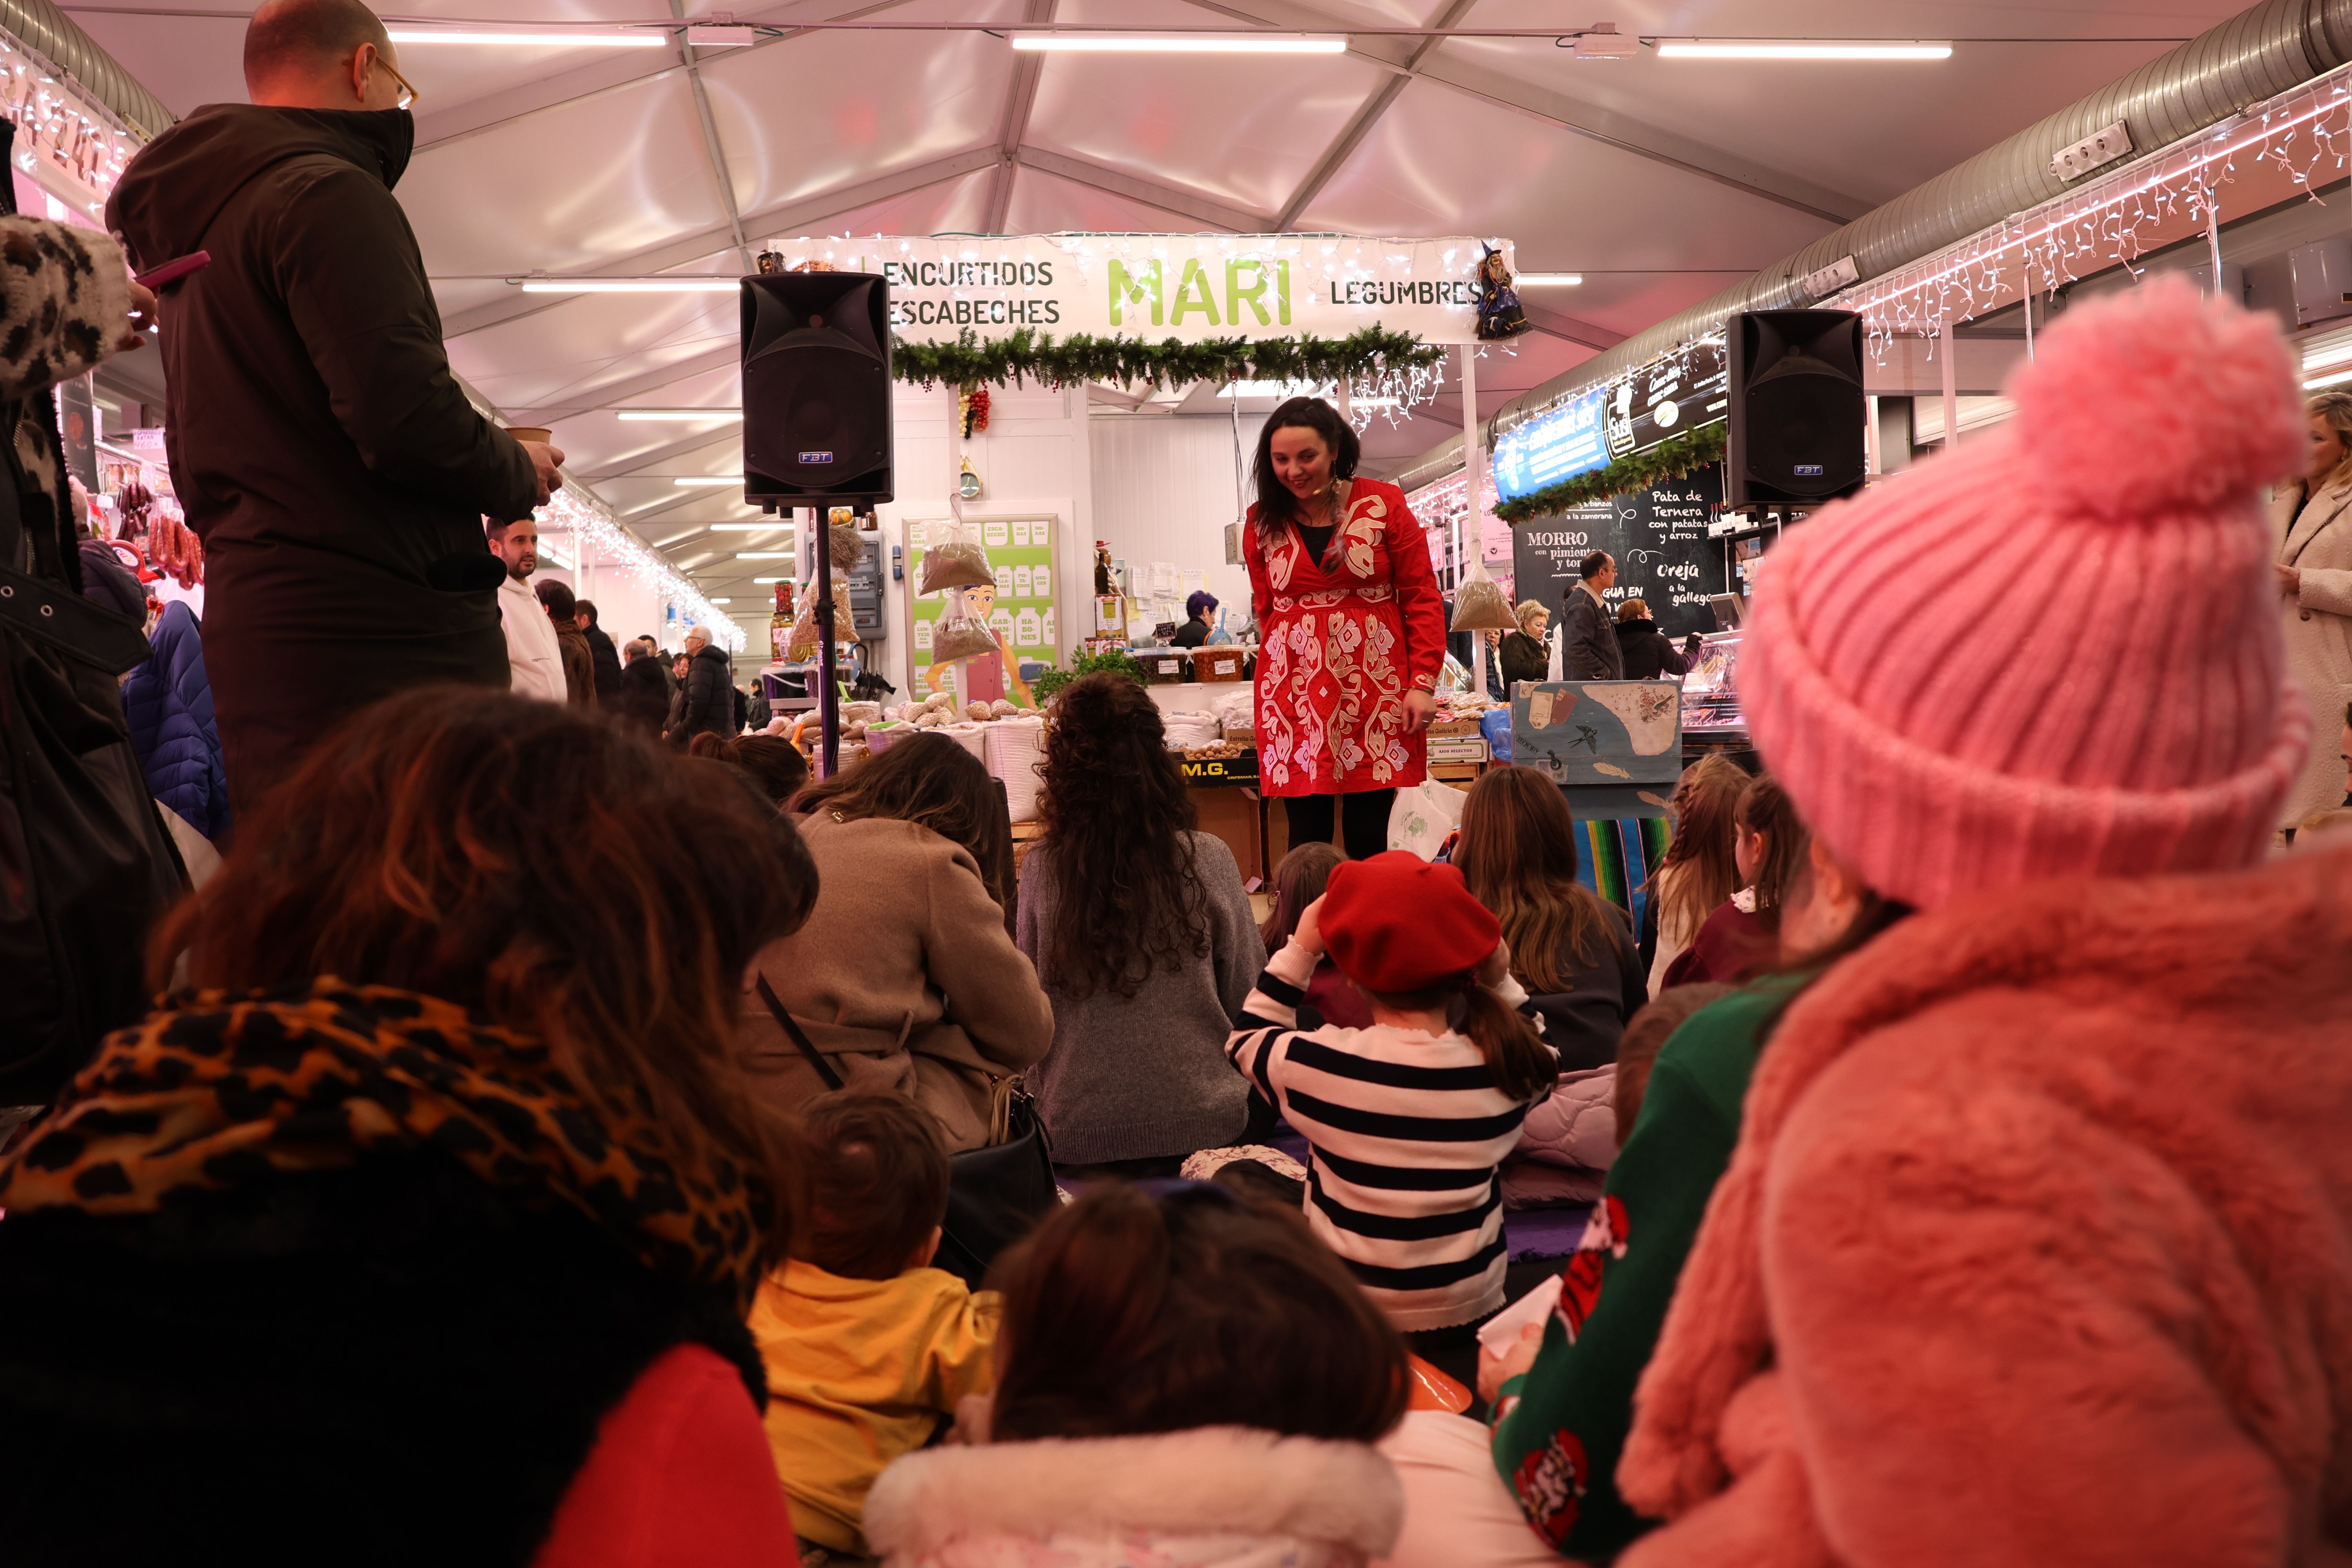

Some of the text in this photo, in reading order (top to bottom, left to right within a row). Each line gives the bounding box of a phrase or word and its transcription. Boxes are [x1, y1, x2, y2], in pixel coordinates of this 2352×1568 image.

[884, 261, 1053, 286] ENCURTIDOS
[1108, 258, 1291, 327] MARI
[1331, 281, 1484, 305] LEGUMBRES
[890, 300, 1060, 325] ESCABECHES
[1610, 413, 1631, 441] Susi
[1652, 490, 1703, 502] Pata de
[1652, 506, 1703, 517] Ternera
[1672, 519, 1708, 532] patatas
[1527, 532, 1588, 546] MORRO
[1659, 533, 1666, 544] y
[1557, 561, 1563, 570] y
[1601, 587, 1643, 597] GUA EN
[1678, 583, 1685, 592] la
[1181, 763, 1228, 776] M.G.
